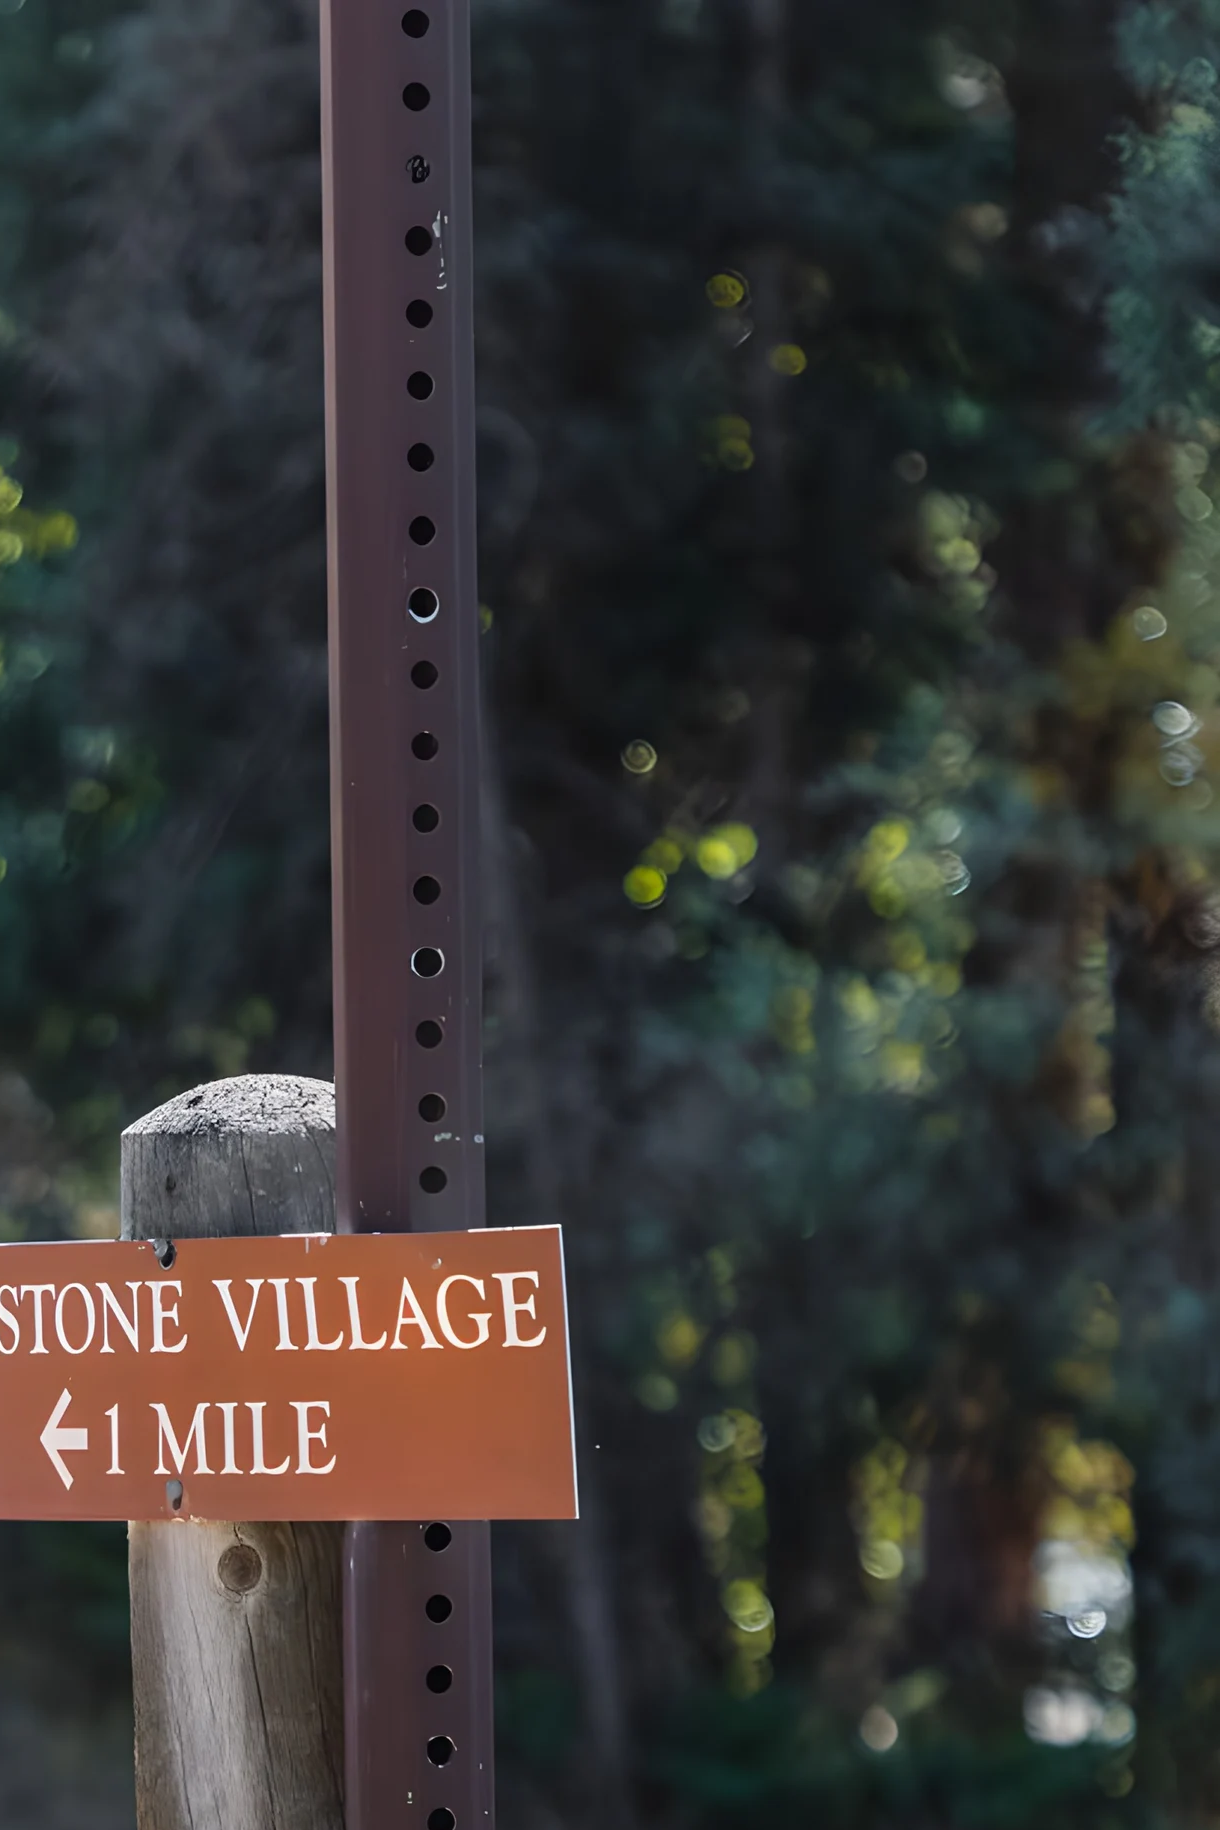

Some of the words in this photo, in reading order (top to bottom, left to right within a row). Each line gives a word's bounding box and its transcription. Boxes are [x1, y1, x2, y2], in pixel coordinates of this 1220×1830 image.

[211, 1270, 548, 1353] VILLAGE
[103, 1402, 127, 1476] 1
[148, 1400, 338, 1476] MILE
